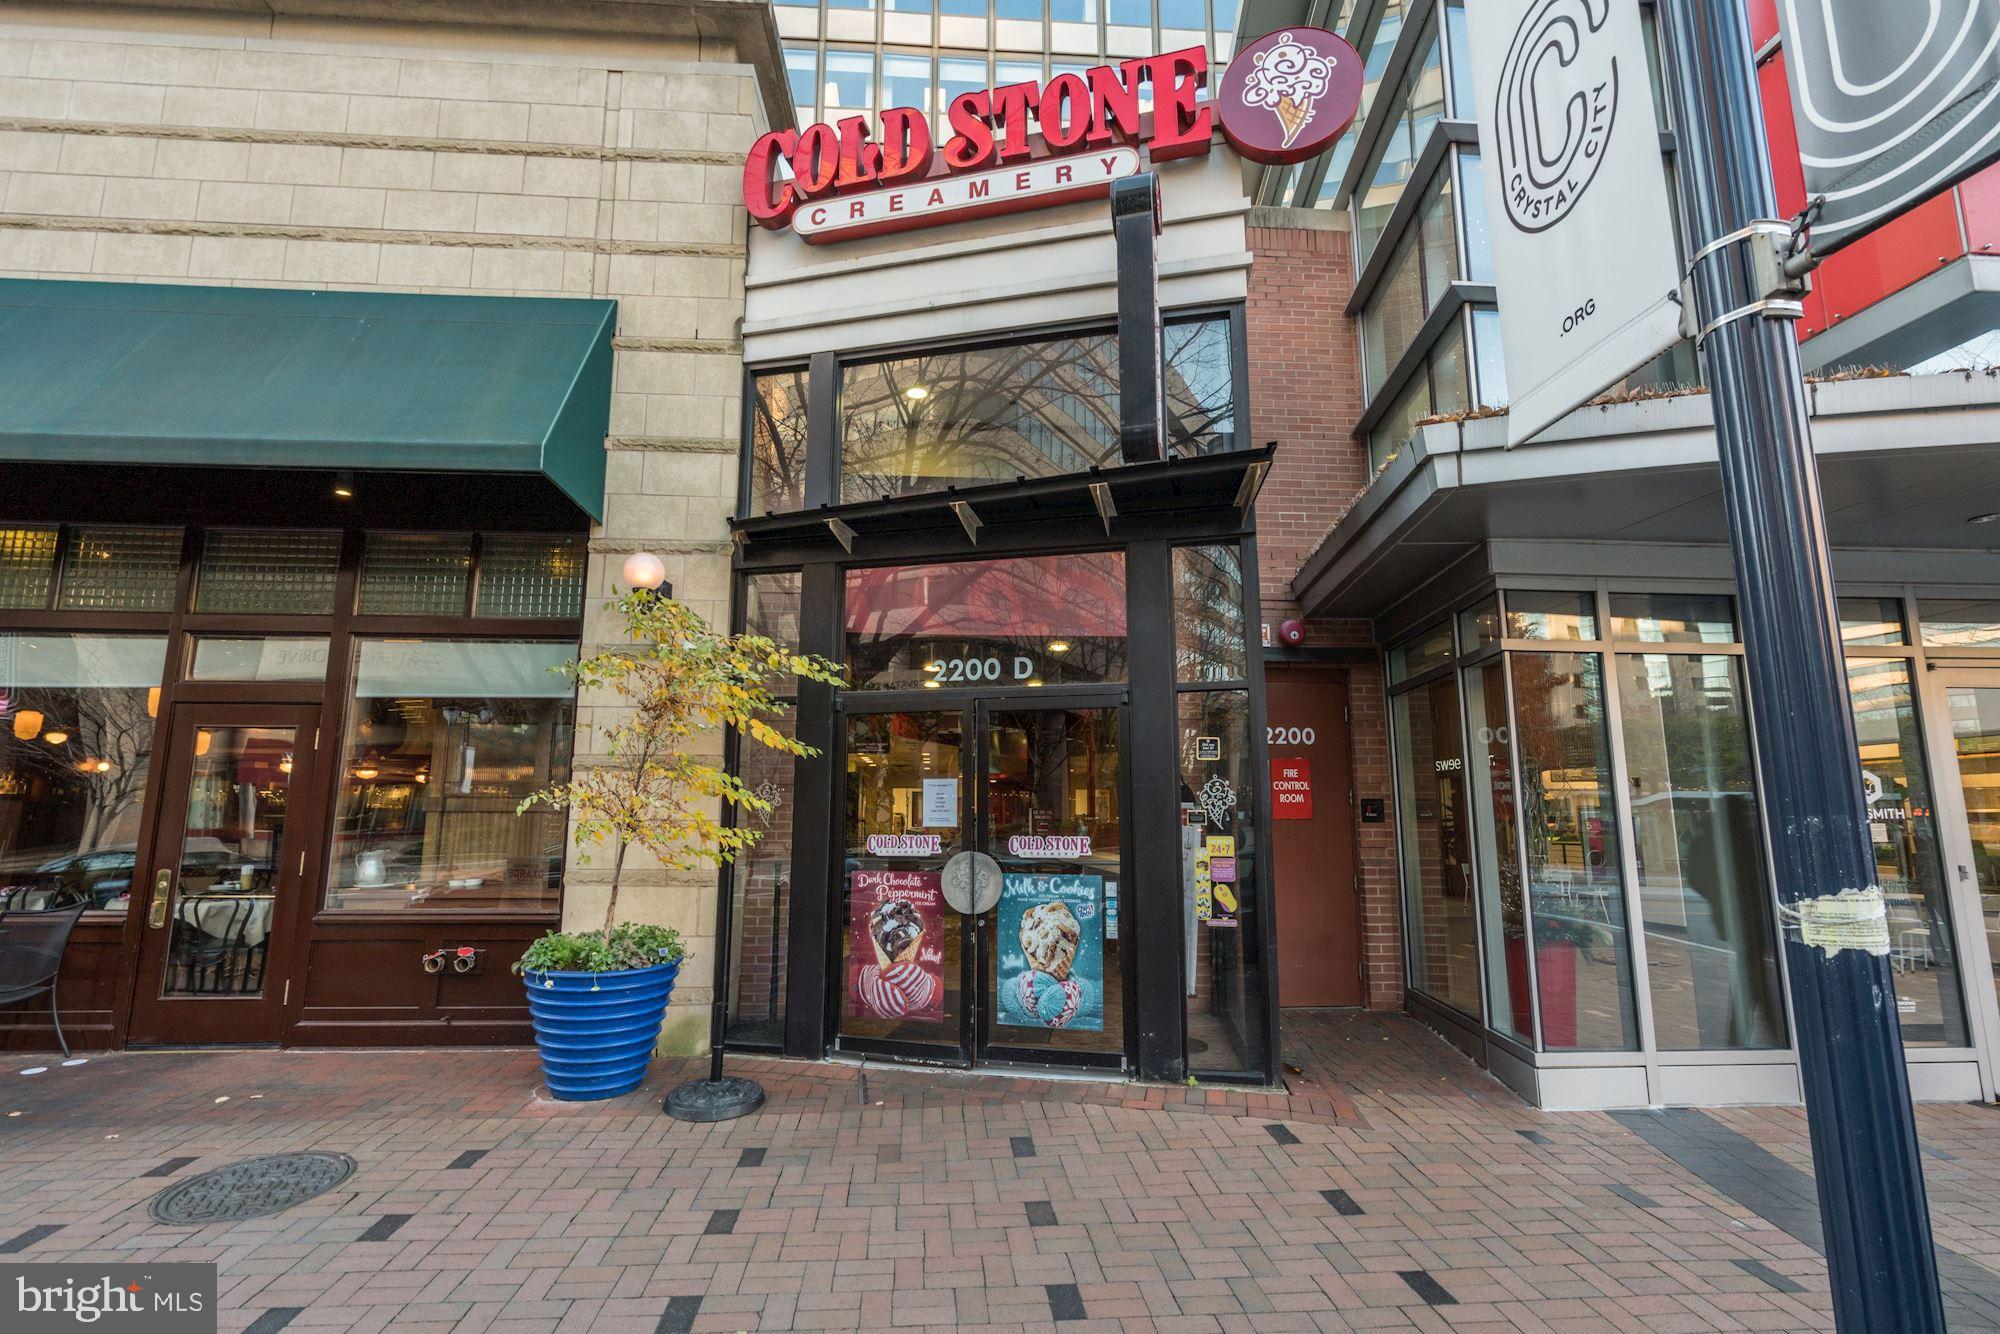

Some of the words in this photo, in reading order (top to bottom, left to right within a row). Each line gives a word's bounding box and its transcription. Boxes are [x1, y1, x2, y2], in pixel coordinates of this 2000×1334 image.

[743, 106, 934, 229] COLD
[943, 45, 1213, 168] STONE
[1511, 173, 1579, 218] CRYSTAL
[1584, 82, 1607, 158] CITY
[811, 156, 1118, 226] CREAMERY
[1560, 298, 1596, 337] .ORG
[933, 657, 1001, 682] 2200
[1014, 656, 1034, 680] D
[1283, 769, 1299, 778] FIRE
[1273, 781, 1310, 791] CONTROL
[1280, 794, 1305, 803] ROOM
[867, 834, 899, 852] COLD
[900, 834, 940, 852] STONE
[1010, 836, 1044, 853] COLD
[1046, 836, 1090, 854] STONE
[858, 873, 883, 888] Dark
[883, 872, 923, 887] Chocolate
[1003, 878, 1037, 897] Milk
[1038, 881, 1048, 892] &
[1049, 877, 1095, 900] Cookies
[876, 885, 938, 903] Peppermint
